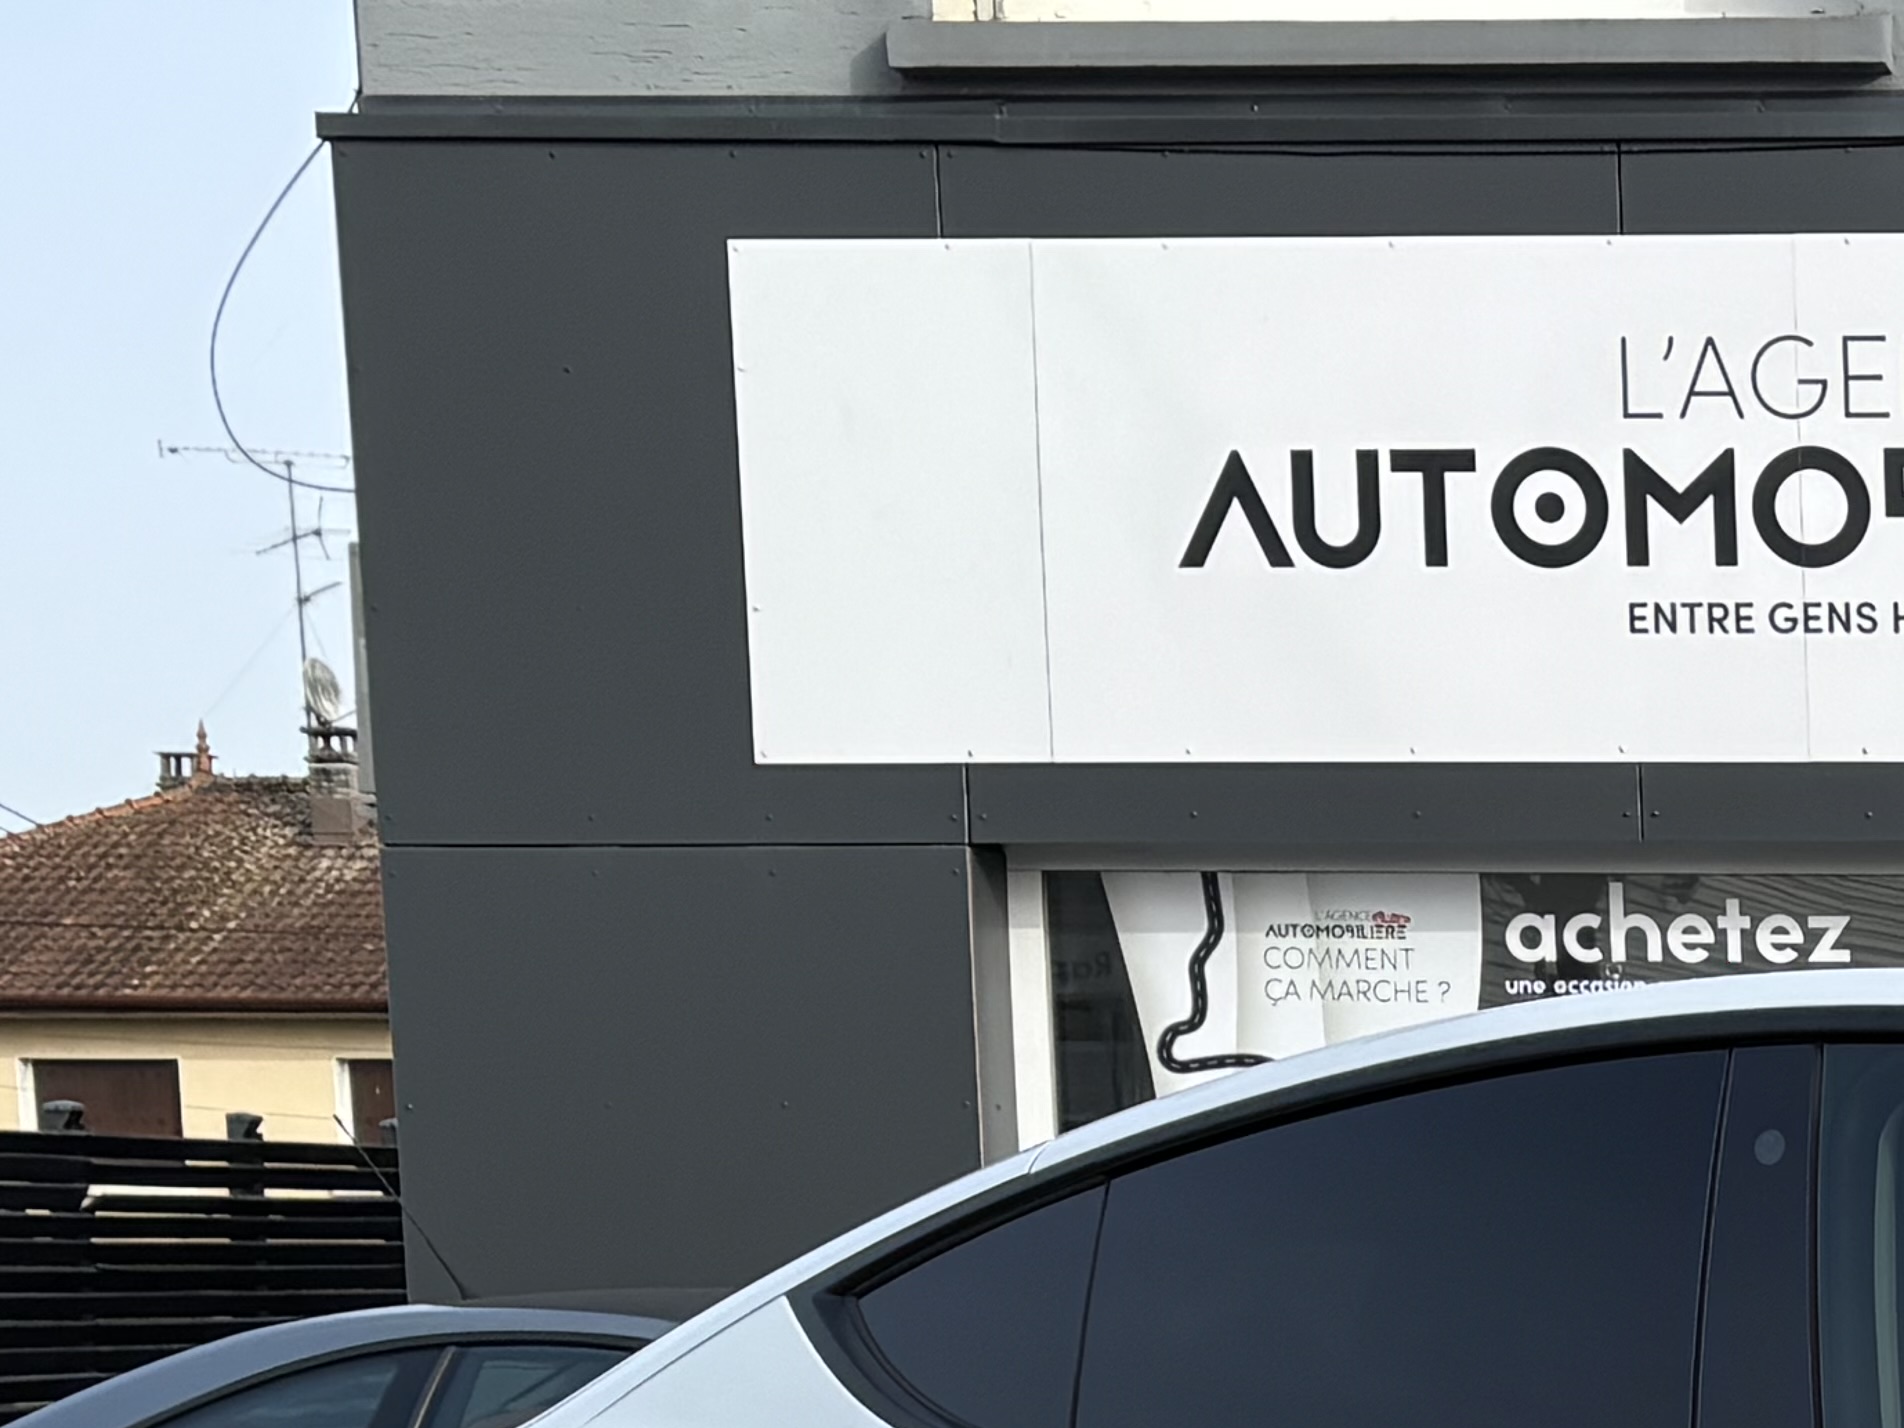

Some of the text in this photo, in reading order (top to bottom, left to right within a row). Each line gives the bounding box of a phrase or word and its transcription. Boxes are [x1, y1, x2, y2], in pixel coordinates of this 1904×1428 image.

[1628, 602, 1755, 635] ENTRE
[1768, 601, 1878, 634] GENS
[1505, 882, 1851, 963] achetez
[1264, 946, 1415, 970] COMMENT
[1264, 977, 1451, 1006] ÇA MARCHE ?
